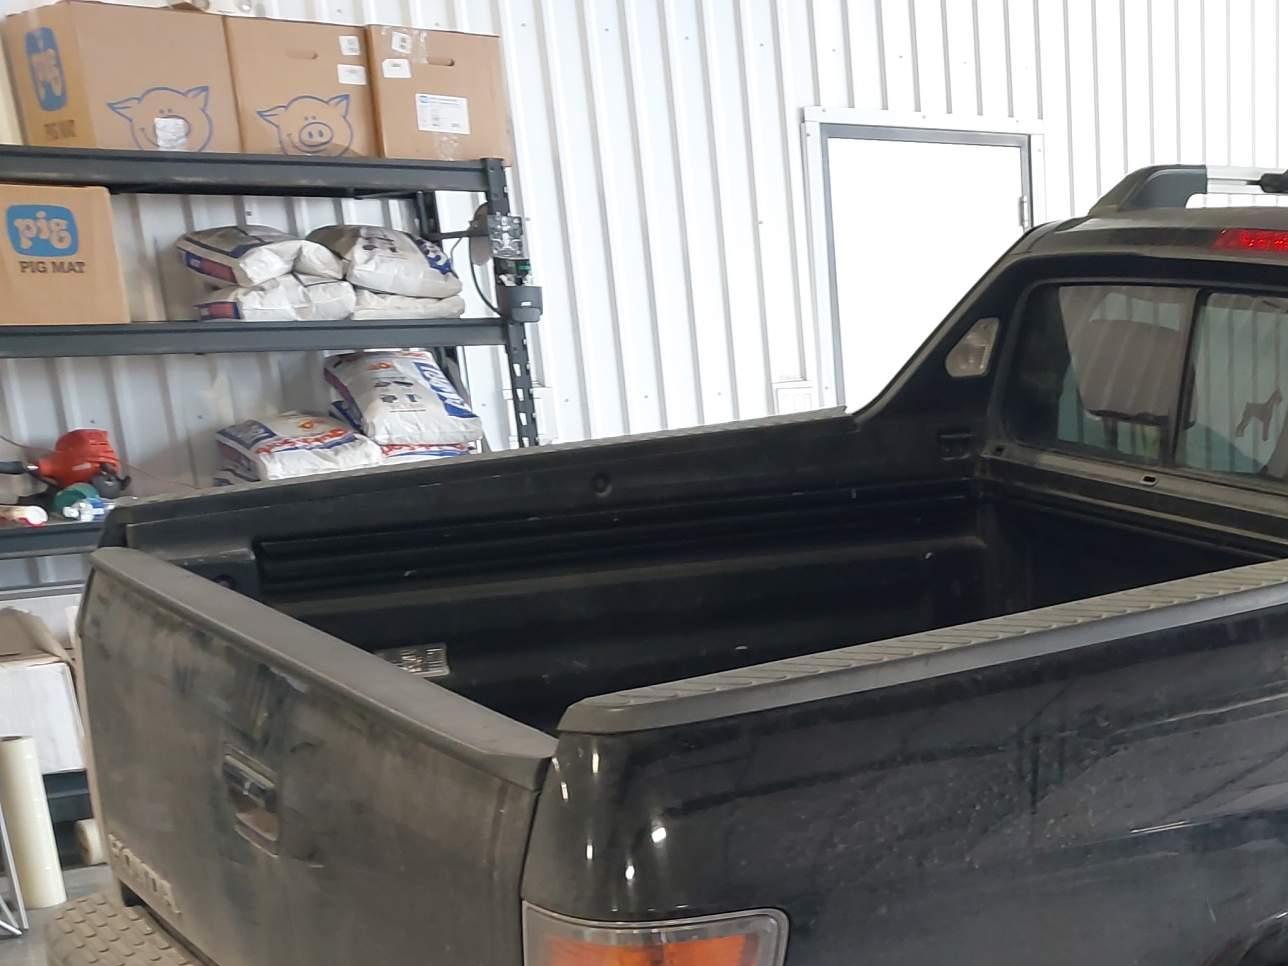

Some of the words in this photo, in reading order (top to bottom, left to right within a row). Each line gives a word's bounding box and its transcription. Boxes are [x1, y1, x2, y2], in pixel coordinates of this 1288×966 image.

[14, 210, 71, 249] pig
[19, 261, 48, 273] PIG
[52, 261, 86, 274] MAT
